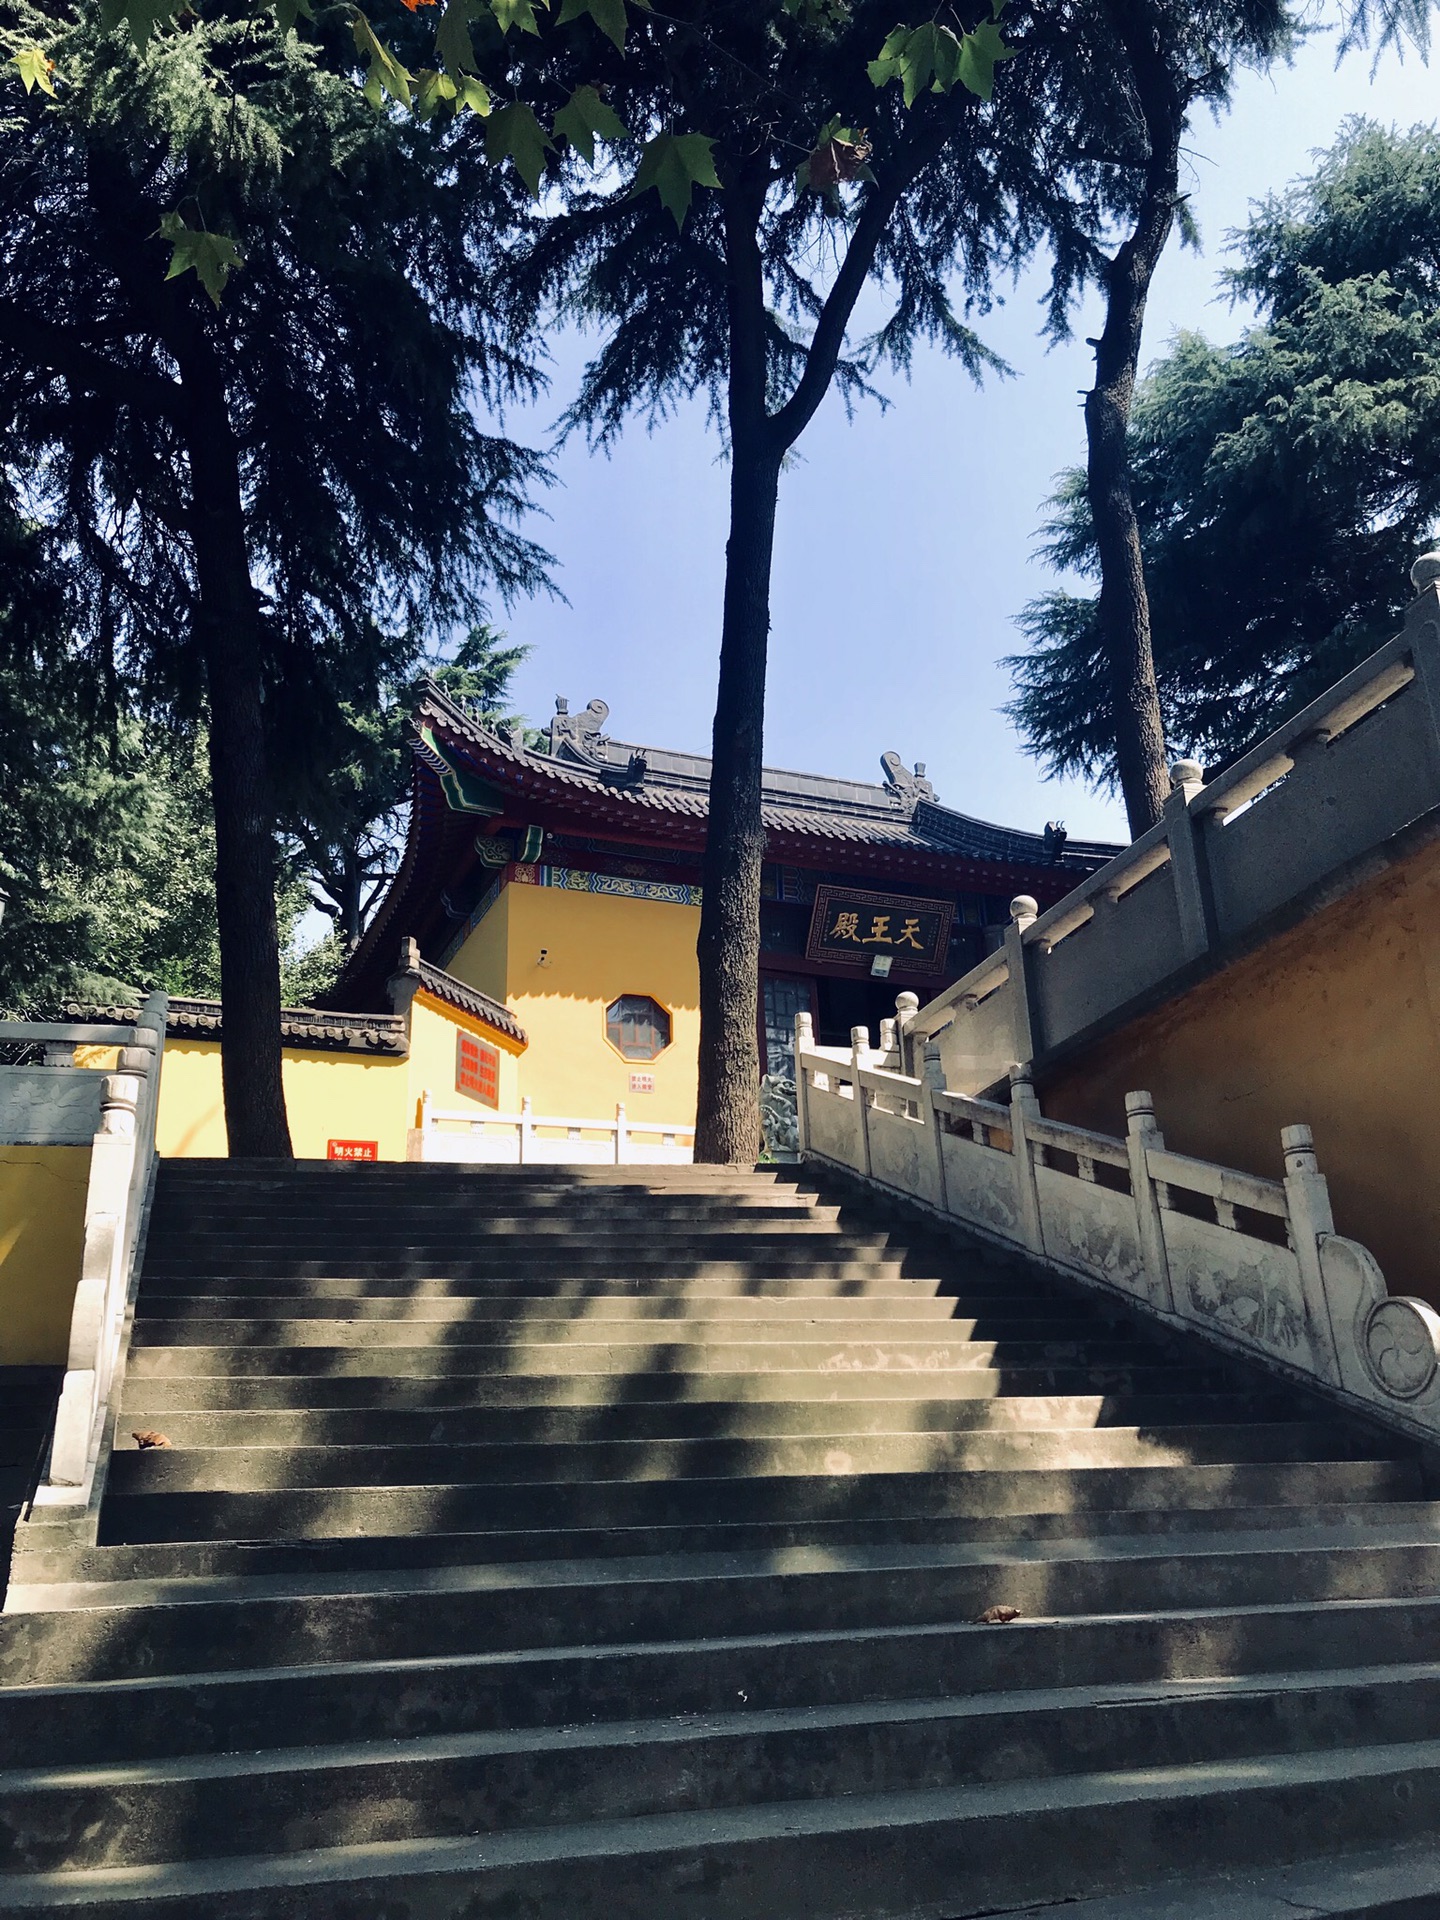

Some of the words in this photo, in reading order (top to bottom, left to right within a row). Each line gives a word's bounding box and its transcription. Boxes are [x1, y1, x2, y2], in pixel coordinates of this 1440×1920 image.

[829, 912, 925, 950] 天王殿
[334, 1146, 373, 1158] 明火禁止
